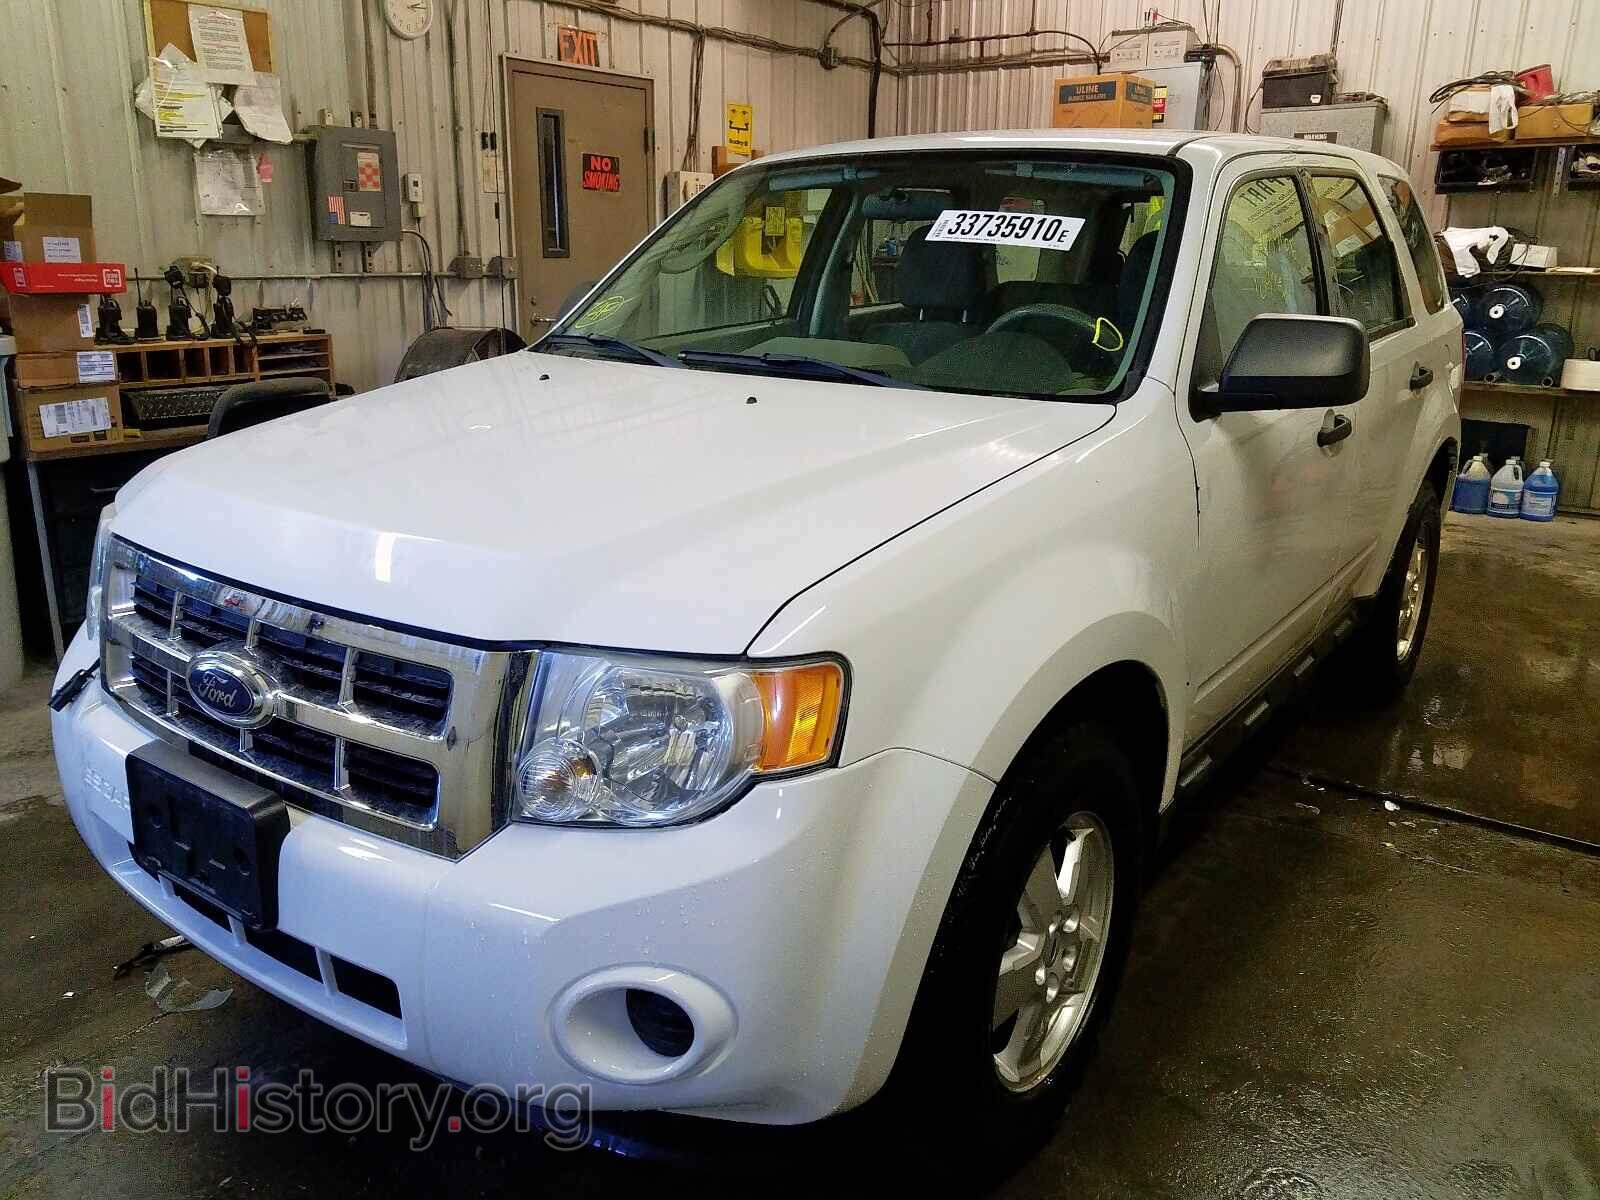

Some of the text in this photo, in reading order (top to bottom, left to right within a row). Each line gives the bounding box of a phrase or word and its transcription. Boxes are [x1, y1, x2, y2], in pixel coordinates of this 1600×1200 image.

[559, 28, 597, 65] EXIT
[590, 155, 612, 171] NO
[583, 171, 620, 190] SMOKING
[197, 670, 238, 709] Ford
